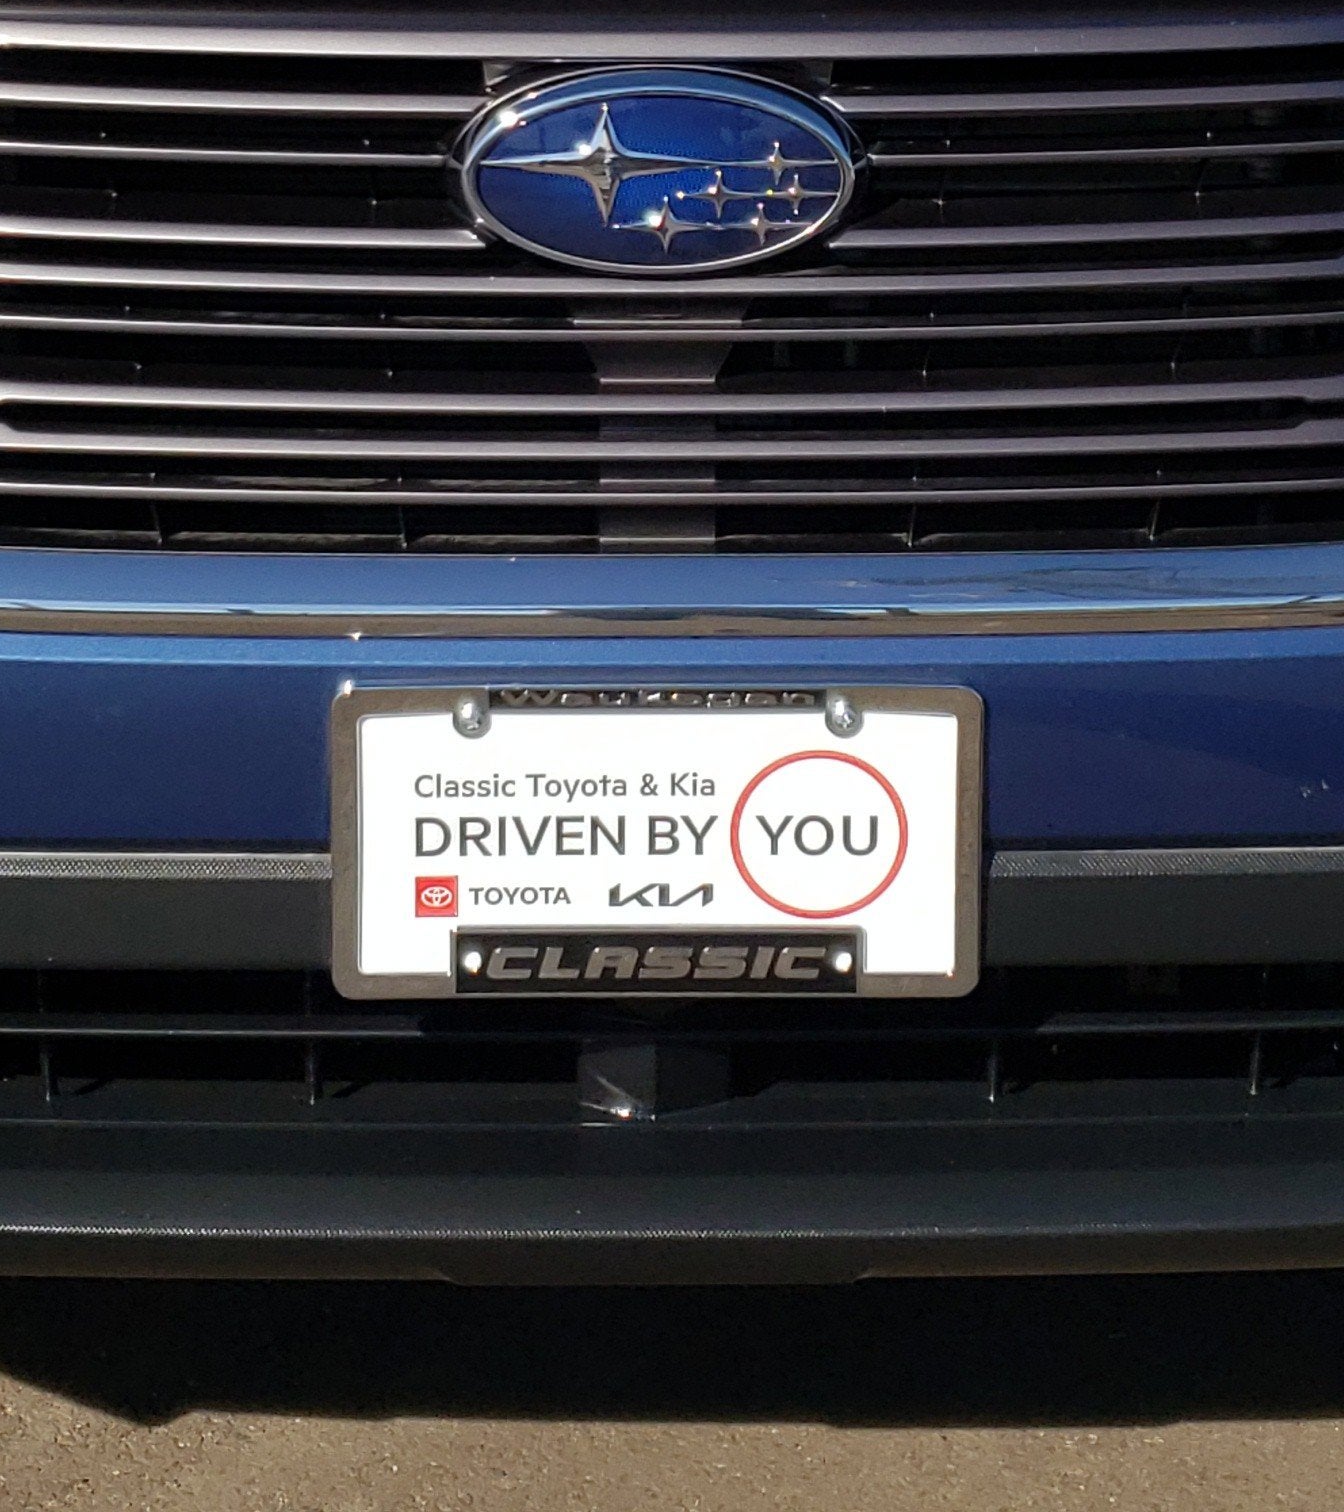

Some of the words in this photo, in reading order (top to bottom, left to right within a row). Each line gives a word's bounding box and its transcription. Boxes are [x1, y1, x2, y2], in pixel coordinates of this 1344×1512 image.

[414, 773, 516, 798] Classic
[525, 773, 627, 803] Toyota
[640, 773, 658, 797] &
[670, 772, 716, 797] Kia
[414, 815, 626, 857] DRIVEN
[647, 815, 719, 856] BY
[755, 815, 879, 856] YOU
[468, 886, 571, 906] TOYOTA
[485, 946, 828, 980] CLASSIC
